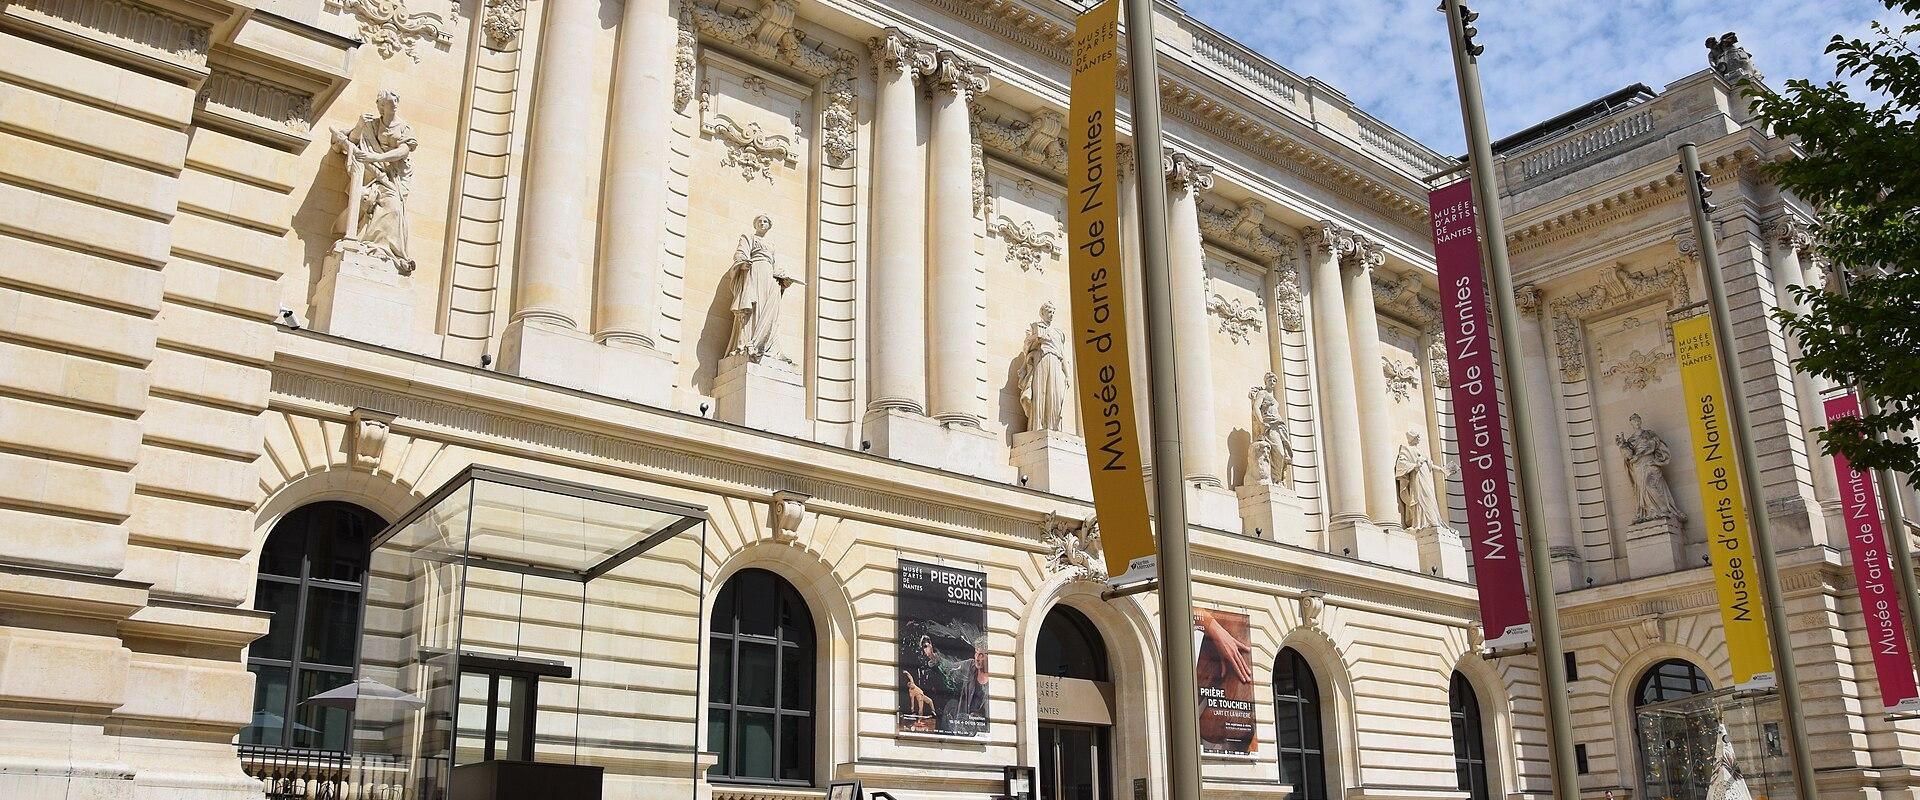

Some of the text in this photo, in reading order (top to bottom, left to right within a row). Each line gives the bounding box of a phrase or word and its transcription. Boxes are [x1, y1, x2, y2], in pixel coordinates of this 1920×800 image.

[1077, 21, 1114, 47] MUSÉE
[1076, 31, 1114, 57] D'ARTS
[1075, 54, 1087, 67] DE
[1075, 50, 1112, 76] NANTES
[1434, 200, 1470, 220] MUSÉE
[1435, 209, 1471, 228] D'ARTS
[1436, 226, 1448, 236] DE
[1437, 226, 1473, 245] NANTES
[1080, 110, 1127, 471] Musée d'arts de Nantes
[1679, 332, 1709, 347] MUSÉE
[1680, 340, 1711, 354] D'ARTS
[1681, 353, 1691, 361] DE
[1682, 354, 1712, 367] NANTES
[1455, 276, 1506, 560] Musée d'arts de Nantes
[1701, 394, 1752, 622] Musée d'arts de Nantes
[1849, 469, 1899, 655] Musée d'arts de Nante
[902, 583, 923, 592] NANTES
[930, 570, 983, 590] PIERRICK
[947, 586, 983, 603] SORIN
[1200, 686, 1225, 698] PRIÈRE
[1040, 706, 1060, 716] ANTES
[1208, 699, 1218, 708] DE
